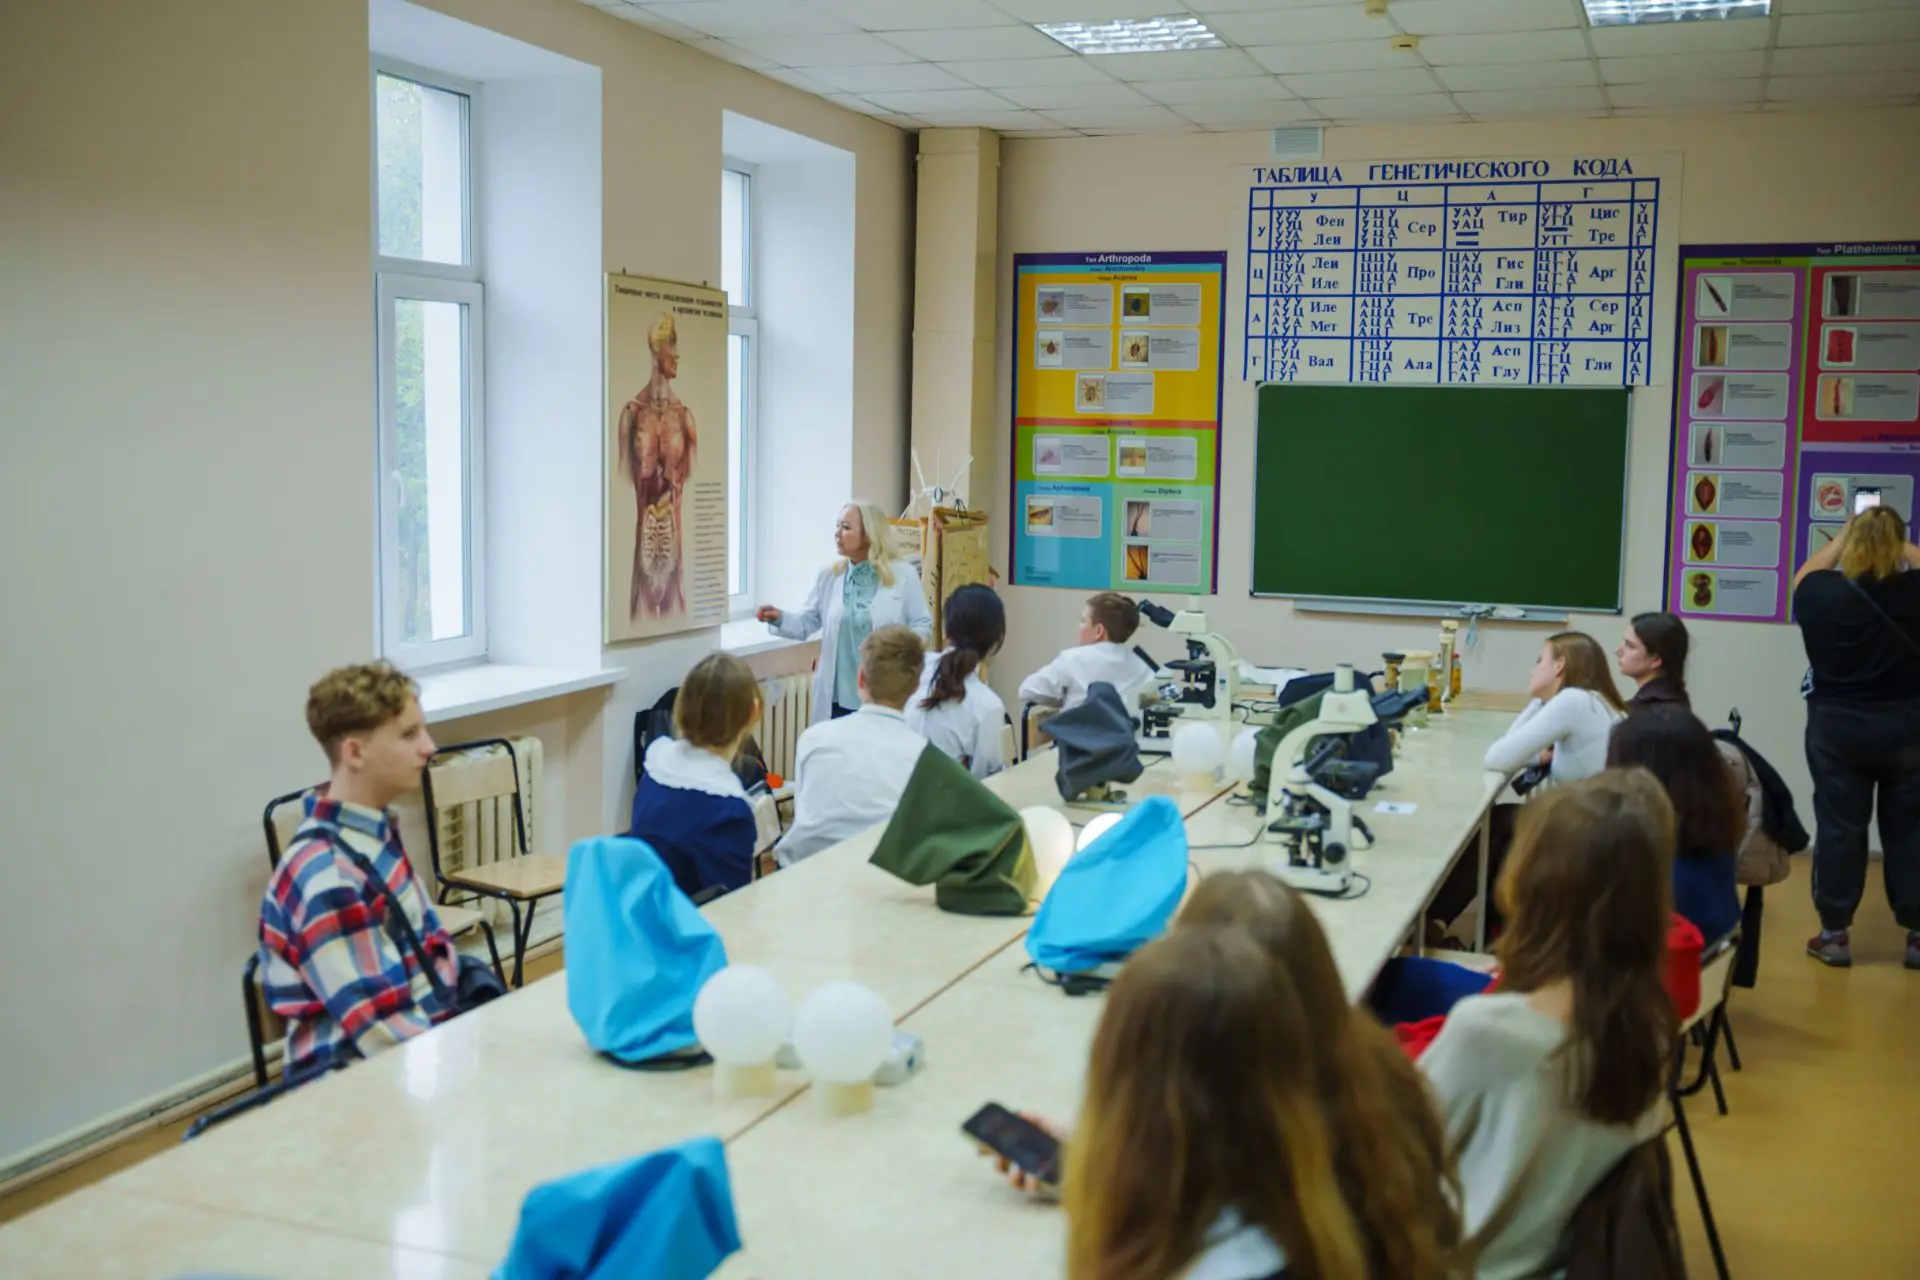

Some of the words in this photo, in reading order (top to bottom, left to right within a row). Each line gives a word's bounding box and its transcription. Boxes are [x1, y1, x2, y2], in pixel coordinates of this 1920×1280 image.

[1252, 166, 1343, 185] ТАБЛИЦА
[1368, 160, 1550, 181] ГЕНЕТИЧЕСКОГО
[1573, 158, 1633, 180] КОДА
[1397, 189, 1409, 202] Ц
[1486, 190, 1496, 201] А
[1582, 187, 1594, 199] Г
[1497, 210, 1528, 225] Тир
[1590, 207, 1620, 220] Цис
[1315, 215, 1345, 227] Фен
[1407, 221, 1437, 237] Сер
[1588, 228, 1616, 245] Тре
[1834, 243, 1916, 255] Plathelmintes
[1098, 254, 1152, 264] Arthropoda
[1496, 256, 1525, 270] Гис
[1253, 268, 1263, 280] Ц
[1407, 266, 1436, 281] Про
[1589, 266, 1617, 282] Арг
[1311, 277, 1339, 289] Иле
[1310, 301, 1337, 313] Иле
[1492, 299, 1522, 312] Асп
[1589, 299, 1619, 315] Сер
[1252, 313, 1261, 323] А
[1408, 312, 1434, 327] Тре
[1310, 320, 1337, 332] Мет
[1491, 321, 1521, 333] Лиз
[1588, 320, 1617, 335] Арг
[1491, 344, 1521, 356] Асп
[1252, 356, 1261, 367] Г
[1309, 355, 1334, 367] Вал
[1404, 358, 1433, 370] Ала
[1492, 366, 1521, 380] Глу
